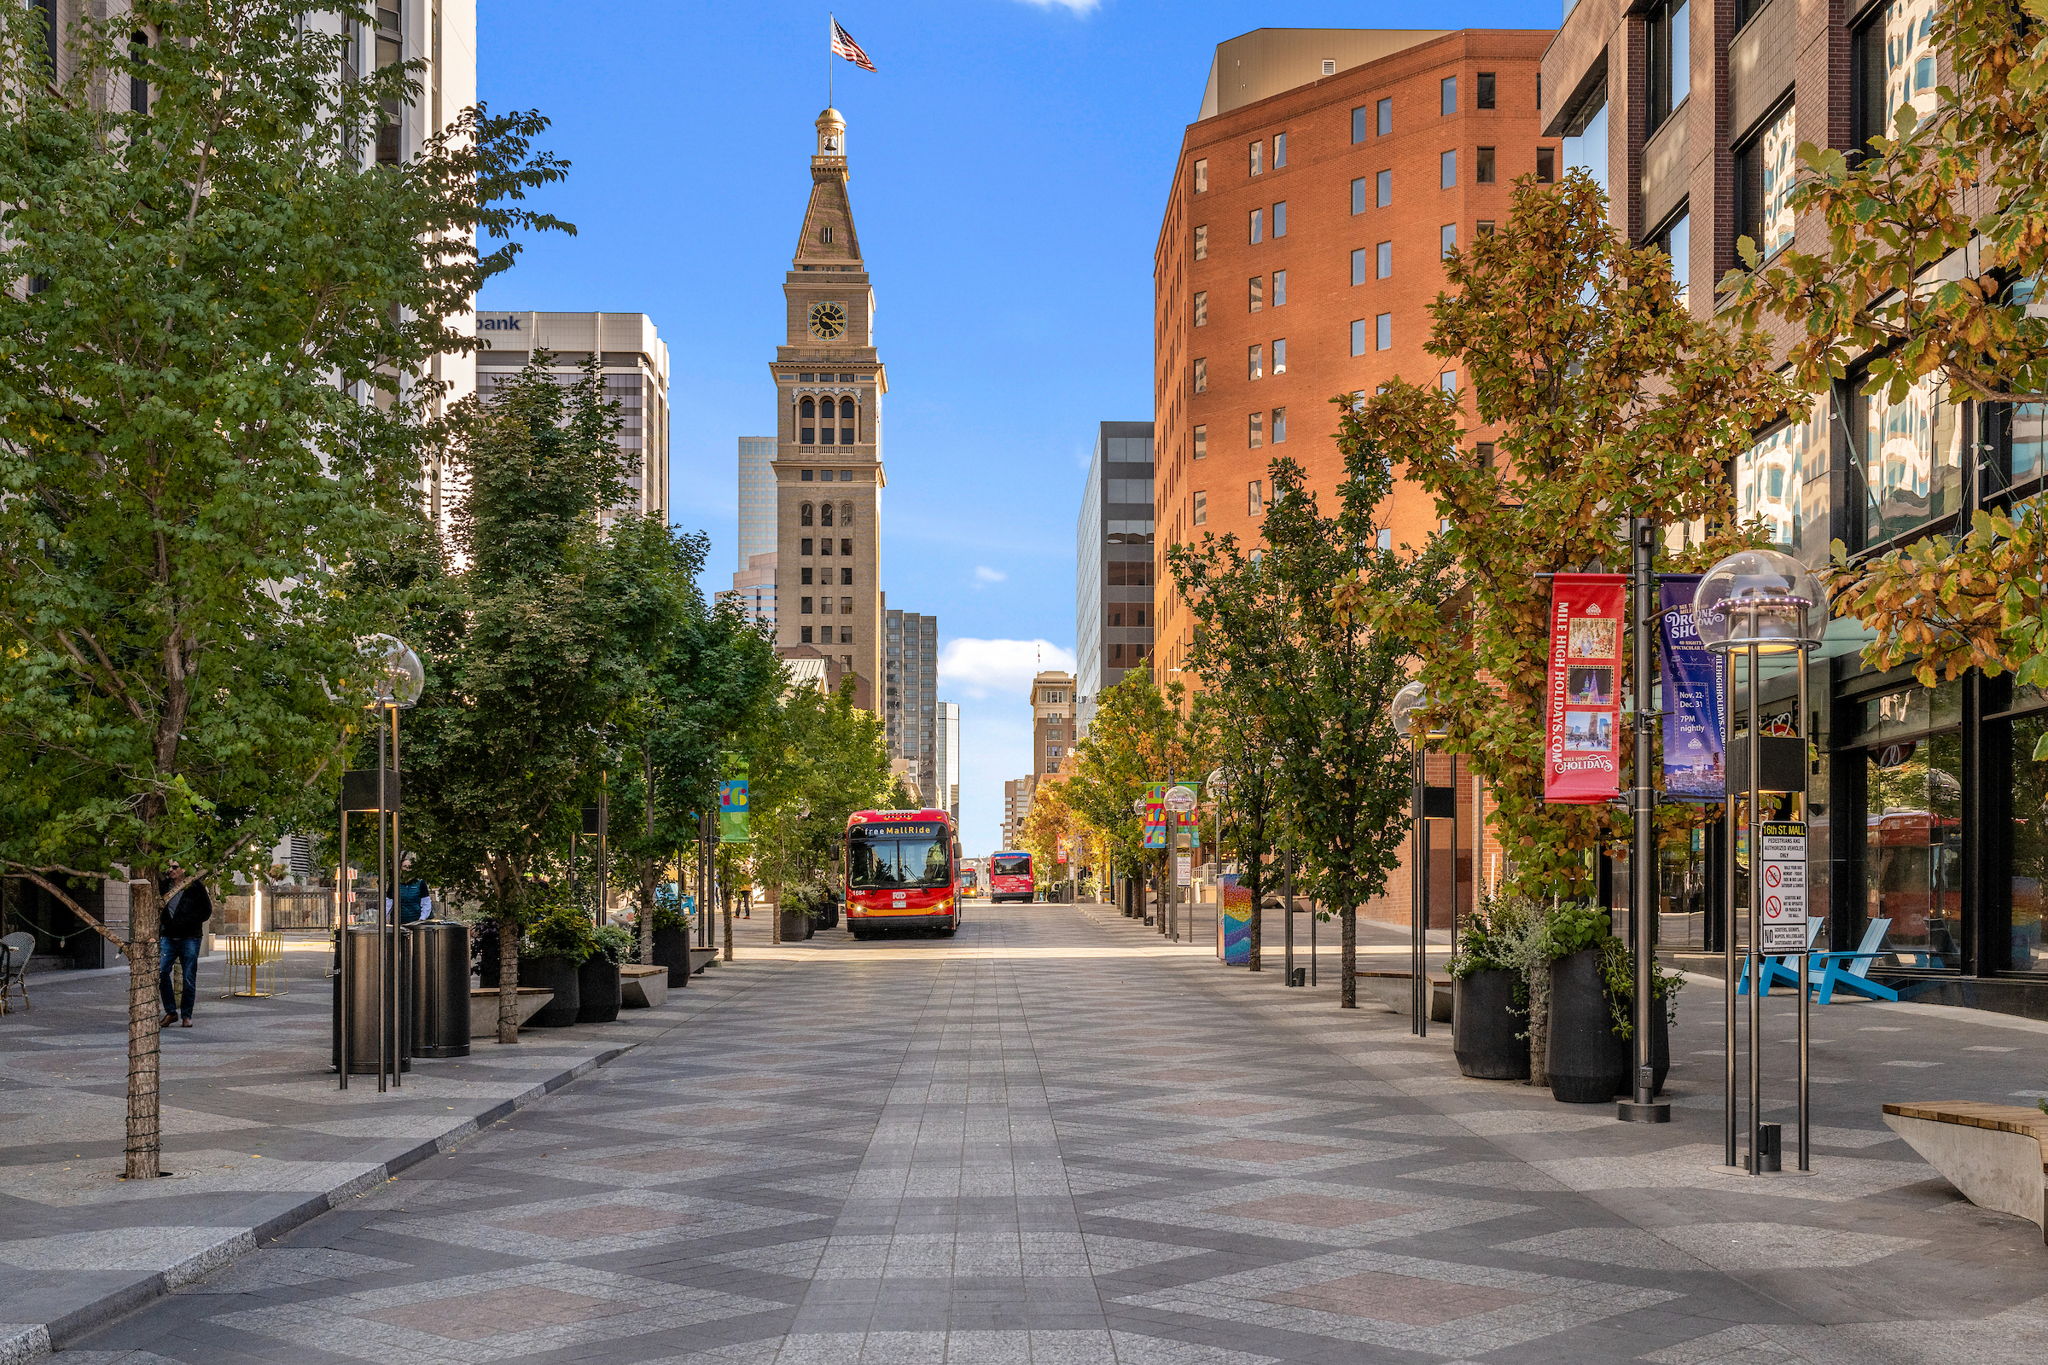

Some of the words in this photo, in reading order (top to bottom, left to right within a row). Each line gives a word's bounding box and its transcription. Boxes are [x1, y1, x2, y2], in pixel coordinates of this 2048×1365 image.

[1556, 602, 1569, 631] MILE
[1665, 608, 1714, 627] DRONE
[1671, 613, 1725, 638] SHOW
[1555, 635, 1567, 667] HIGH
[1680, 691, 1694, 699] Nov.
[1680, 700, 1694, 708] Dec.
[1695, 700, 1703, 708] 31
[1552, 672, 1565, 763] HOLIDAYS.COM
[1680, 724, 1705, 733] nightly
[1555, 754, 1613, 774] HOLIDAYS
[721, 787, 747, 806] 16
[1763, 825, 1777, 835] 16th
[1778, 825, 1788, 835] ST.
[1789, 825, 1805, 835] MALL
